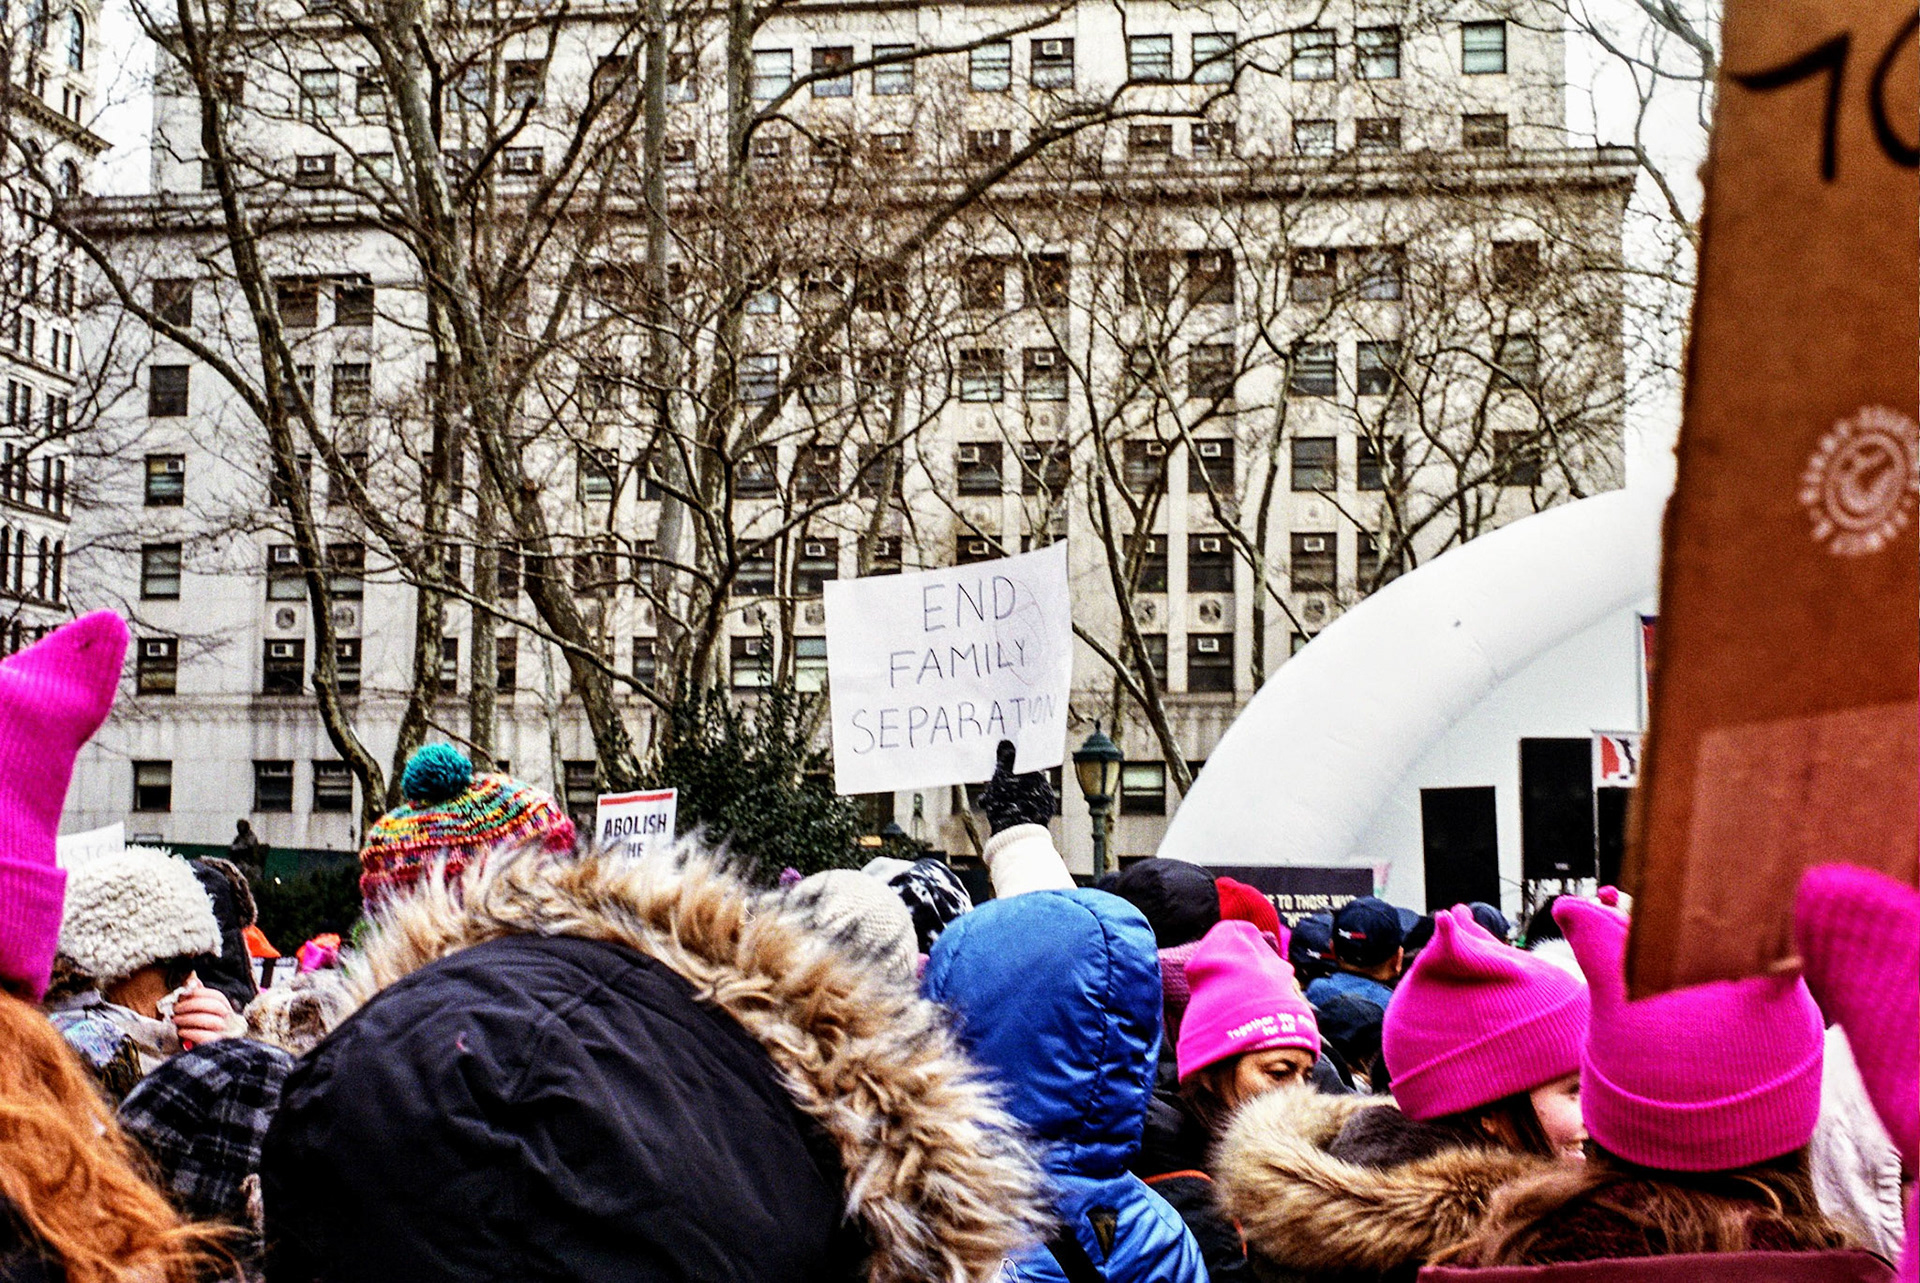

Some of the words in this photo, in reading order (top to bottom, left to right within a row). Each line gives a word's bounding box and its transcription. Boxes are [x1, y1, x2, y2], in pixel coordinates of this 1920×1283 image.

[923, 575, 1016, 632] END
[890, 638, 1025, 688] FAMILY
[603, 813, 667, 837] ABOLISH
[1276, 894, 1293, 911] TO
[1330, 894, 1357, 910] WH
[1226, 1015, 1274, 1040] Together
